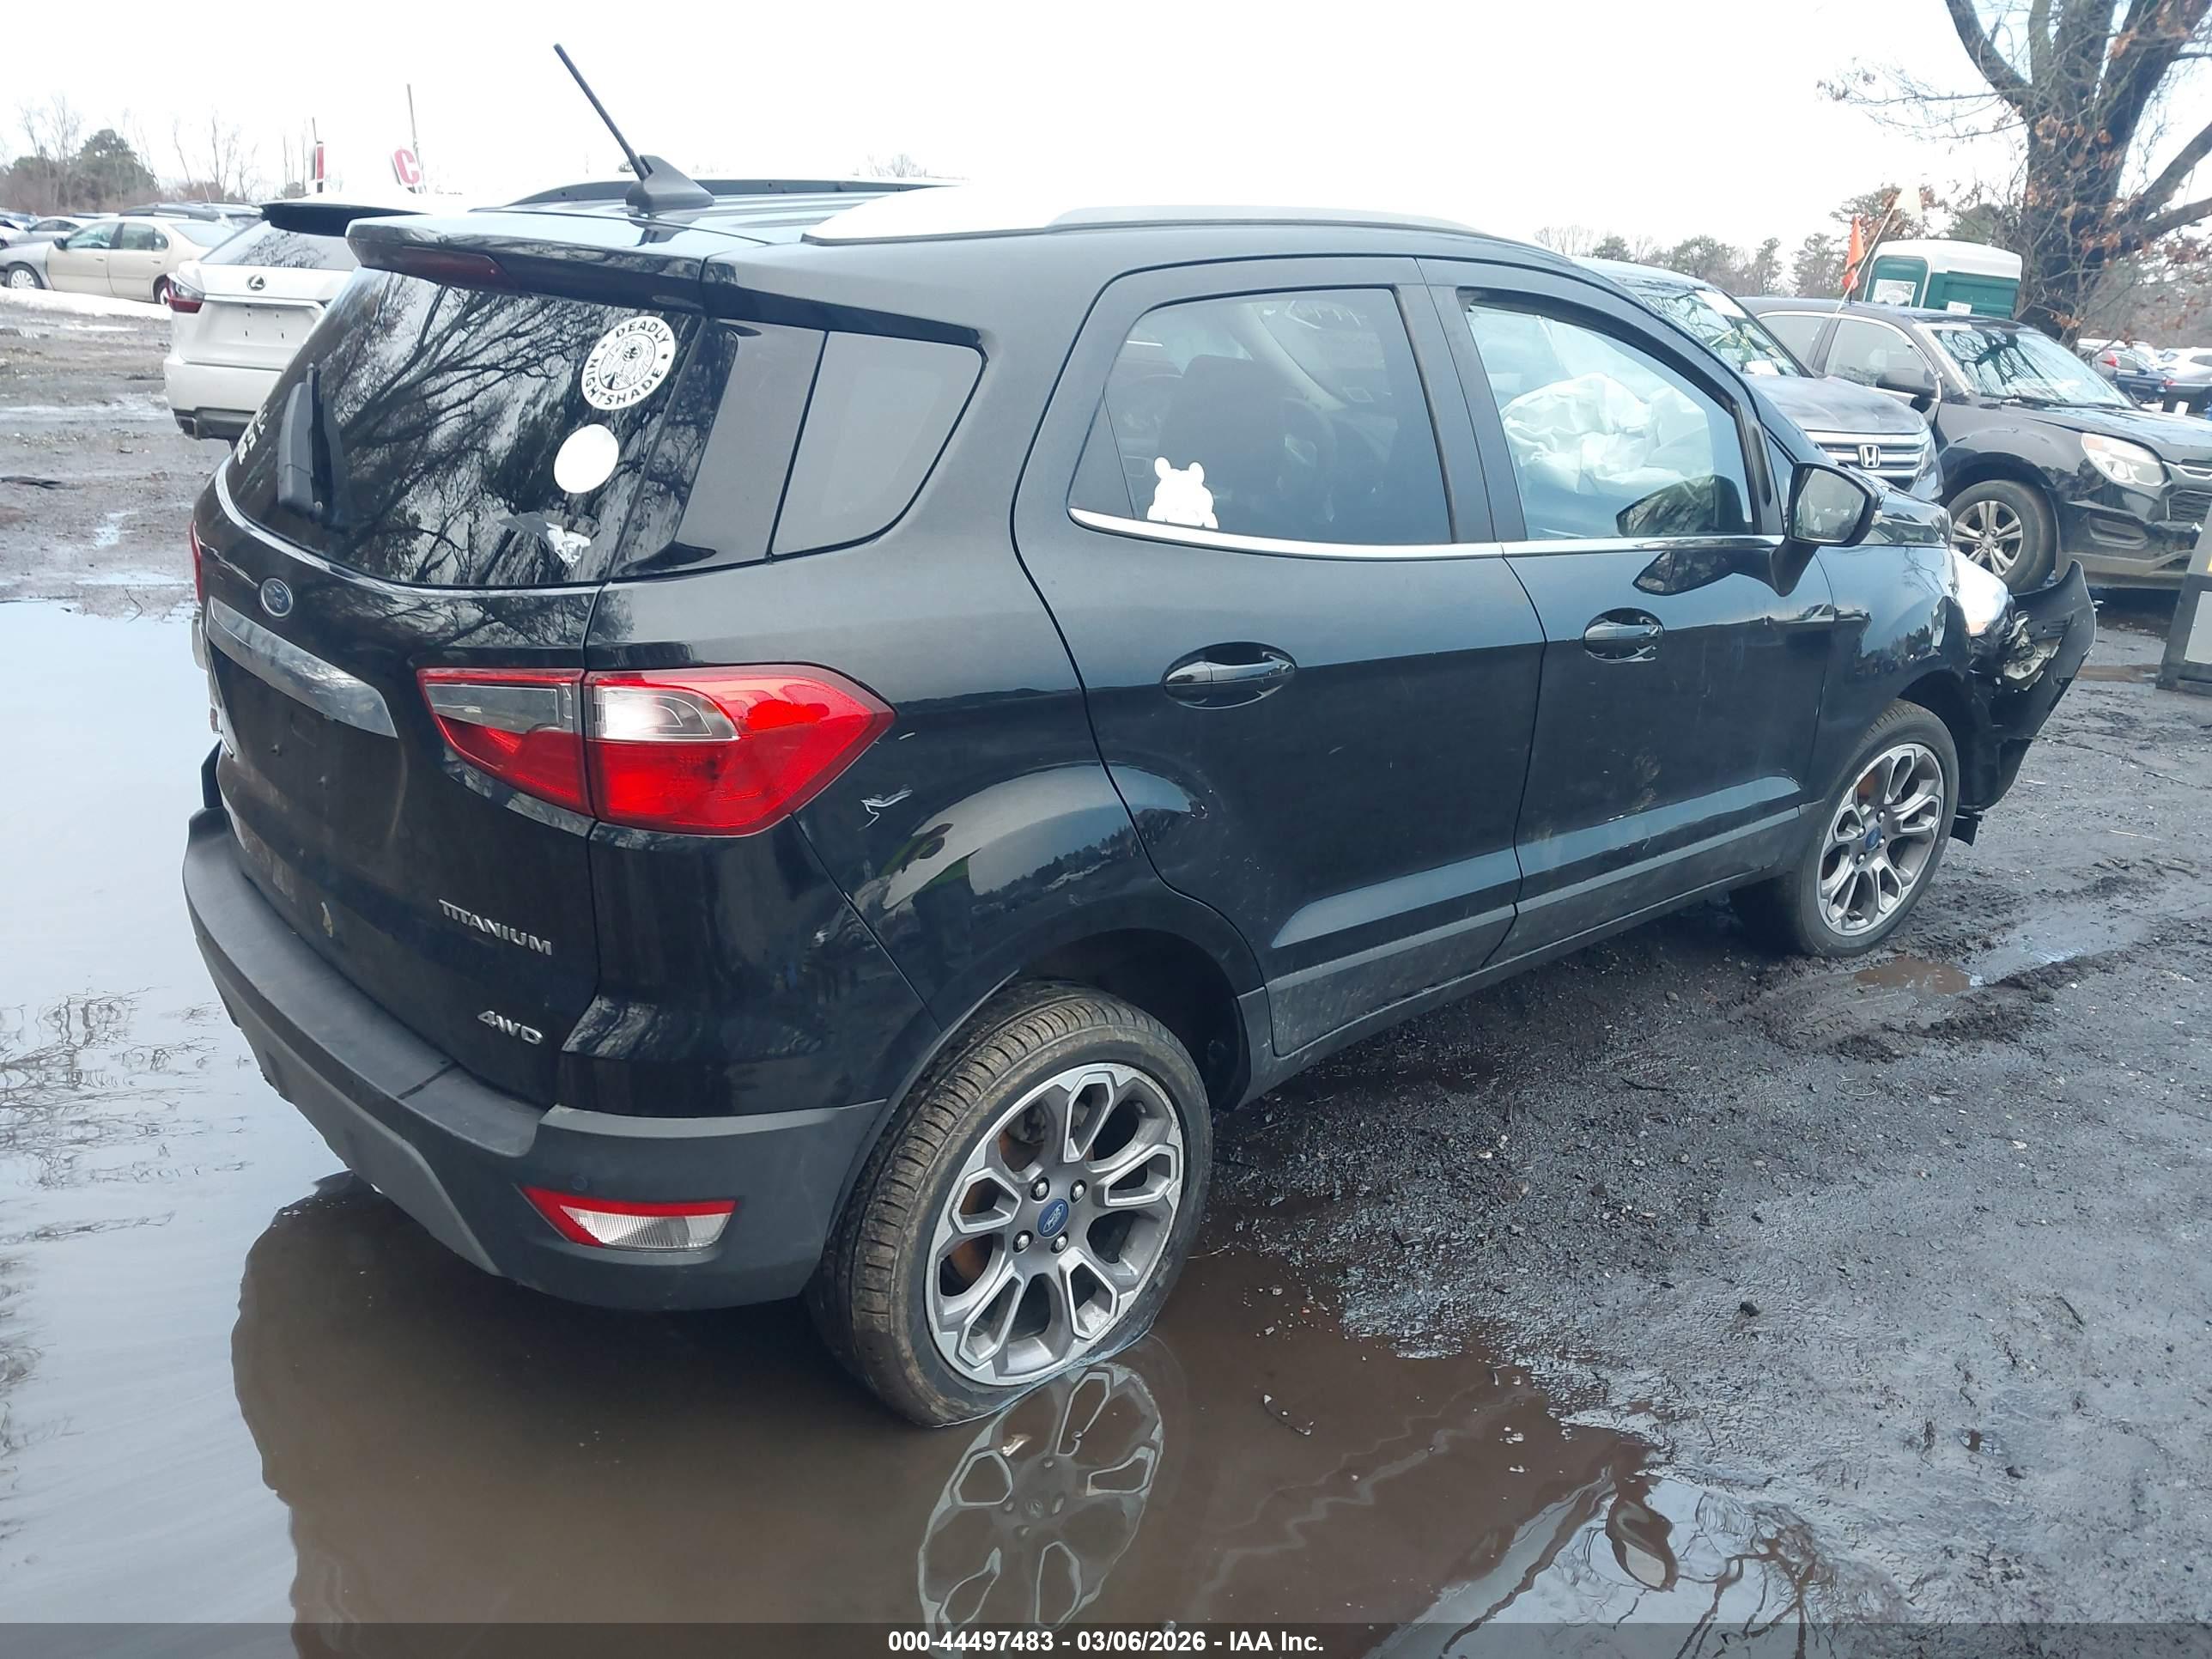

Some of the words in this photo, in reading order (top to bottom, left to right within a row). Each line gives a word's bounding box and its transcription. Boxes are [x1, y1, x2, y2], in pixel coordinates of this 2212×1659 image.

[394, 149, 420, 185] C
[616, 319, 670, 344] DEADLY
[586, 358, 663, 405] NIGHTSHADE
[438, 898, 553, 955] TITANIUM
[477, 1010, 544, 1046] 4WD
